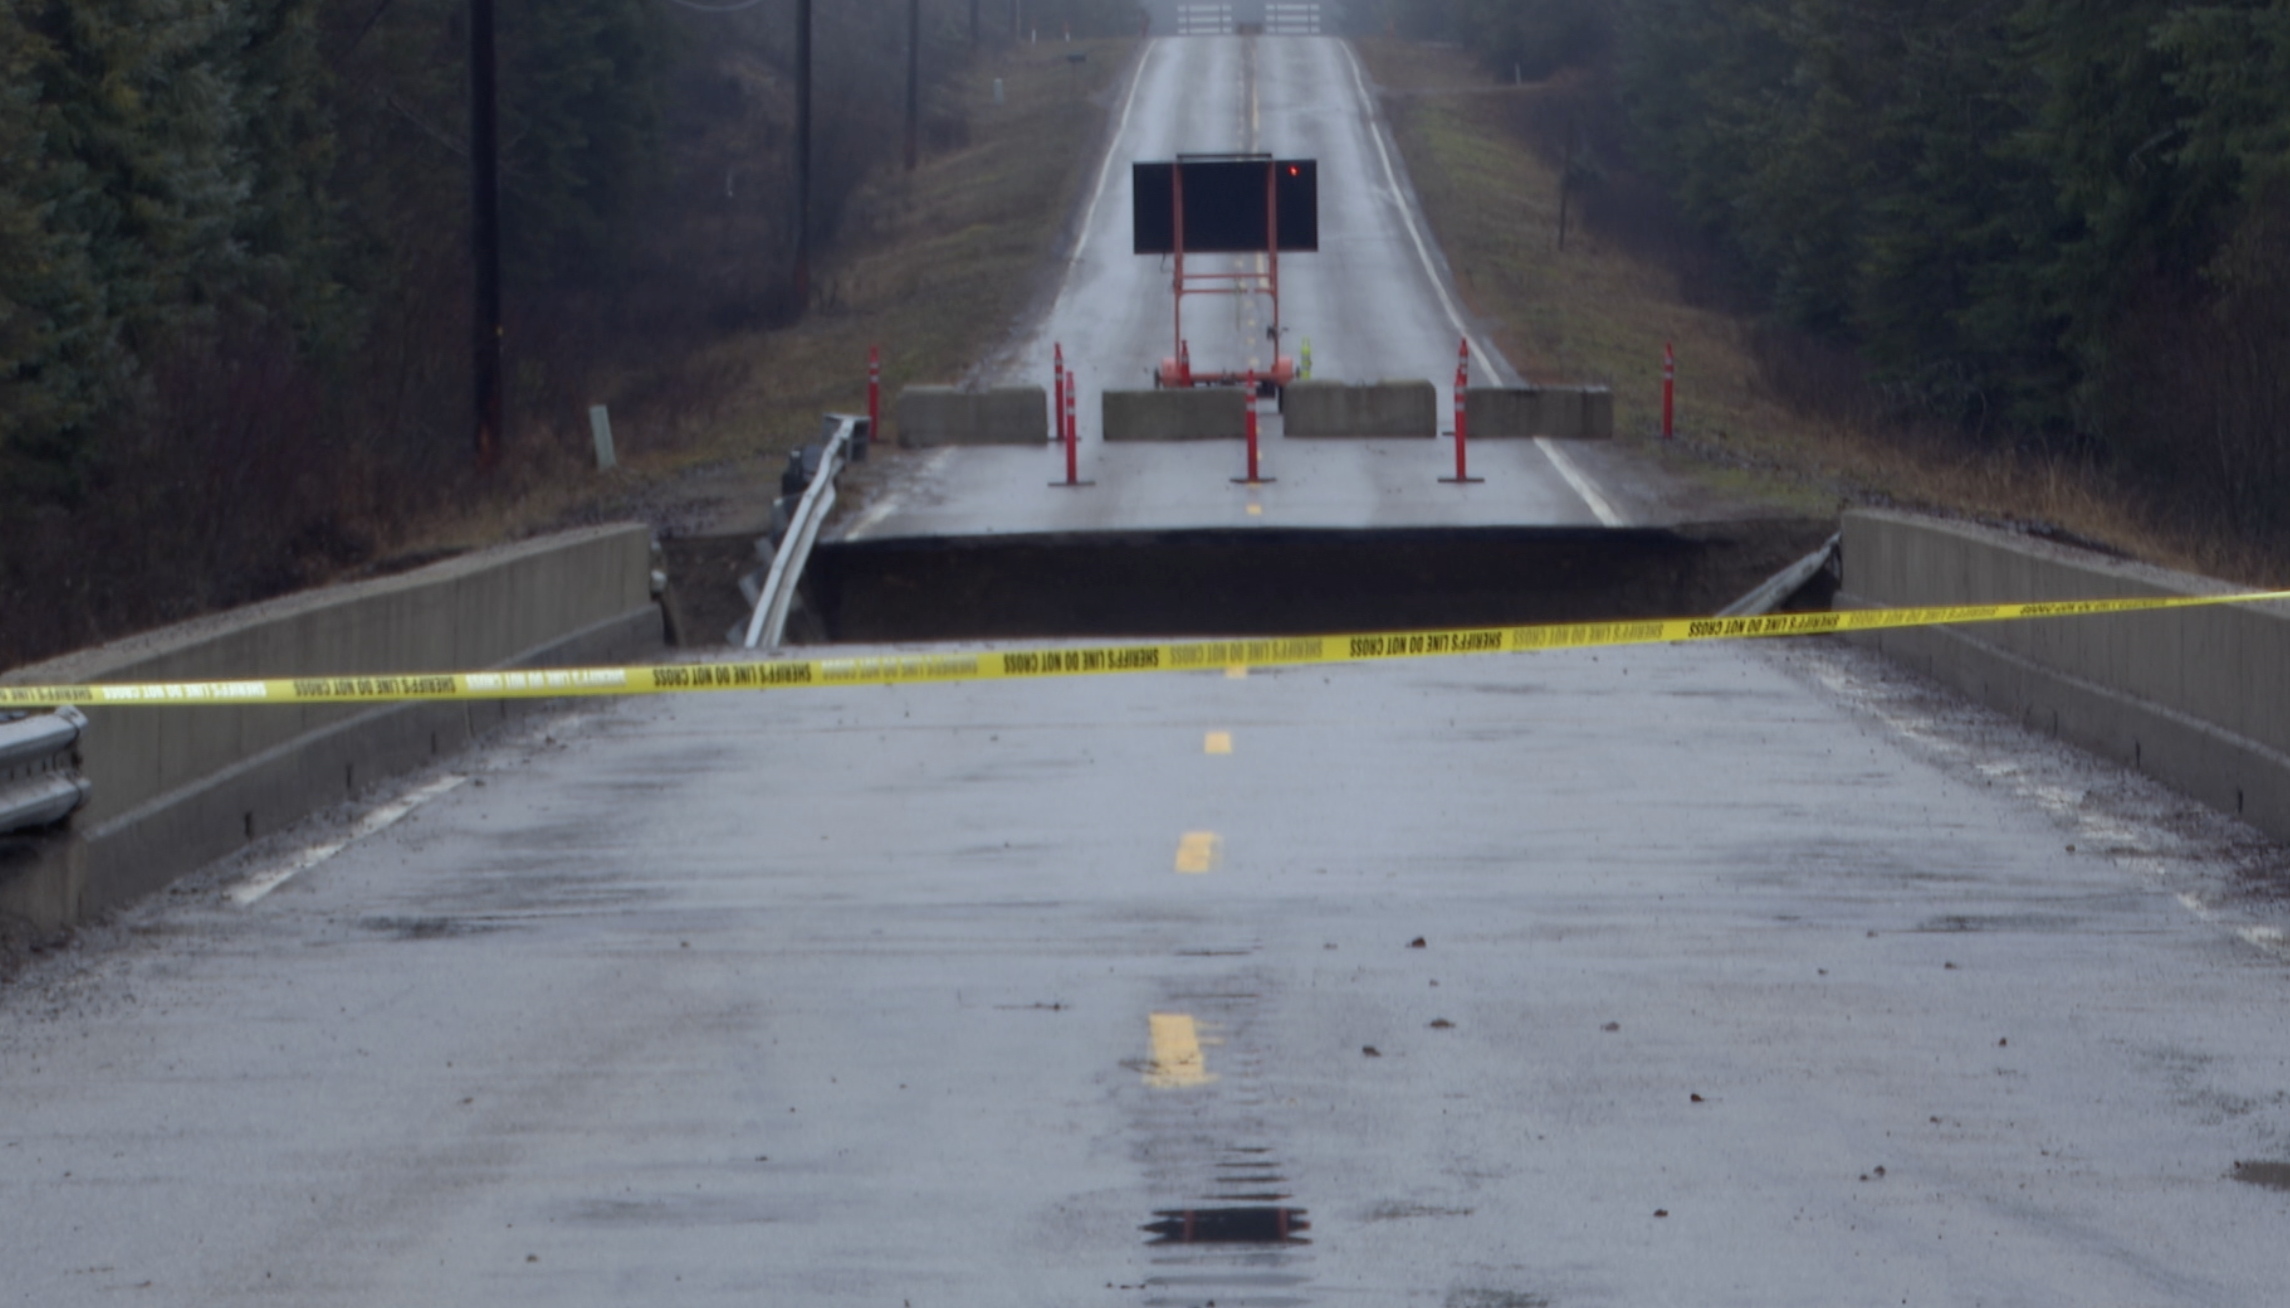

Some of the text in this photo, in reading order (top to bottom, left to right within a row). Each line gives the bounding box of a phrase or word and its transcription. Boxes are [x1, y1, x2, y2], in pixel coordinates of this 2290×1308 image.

[1688, 621, 1723, 638] CROSS
[1725, 619, 1745, 636] NOT
[1747, 618, 1762, 634] DO
[1764, 616, 1787, 632] LINE
[1350, 631, 1501, 657] SHERIFF'S LINE DO NOT CROSS
[1004, 652, 1038, 673] CROSS
[1041, 651, 1061, 672] NOT
[1065, 650, 1079, 671] DO
[1083, 649, 1105, 670] LINE
[653, 669, 689, 687] CROSS
[692, 667, 713, 686] NOT
[715, 666, 730, 685] DO
[733, 665, 757, 684] LINE
